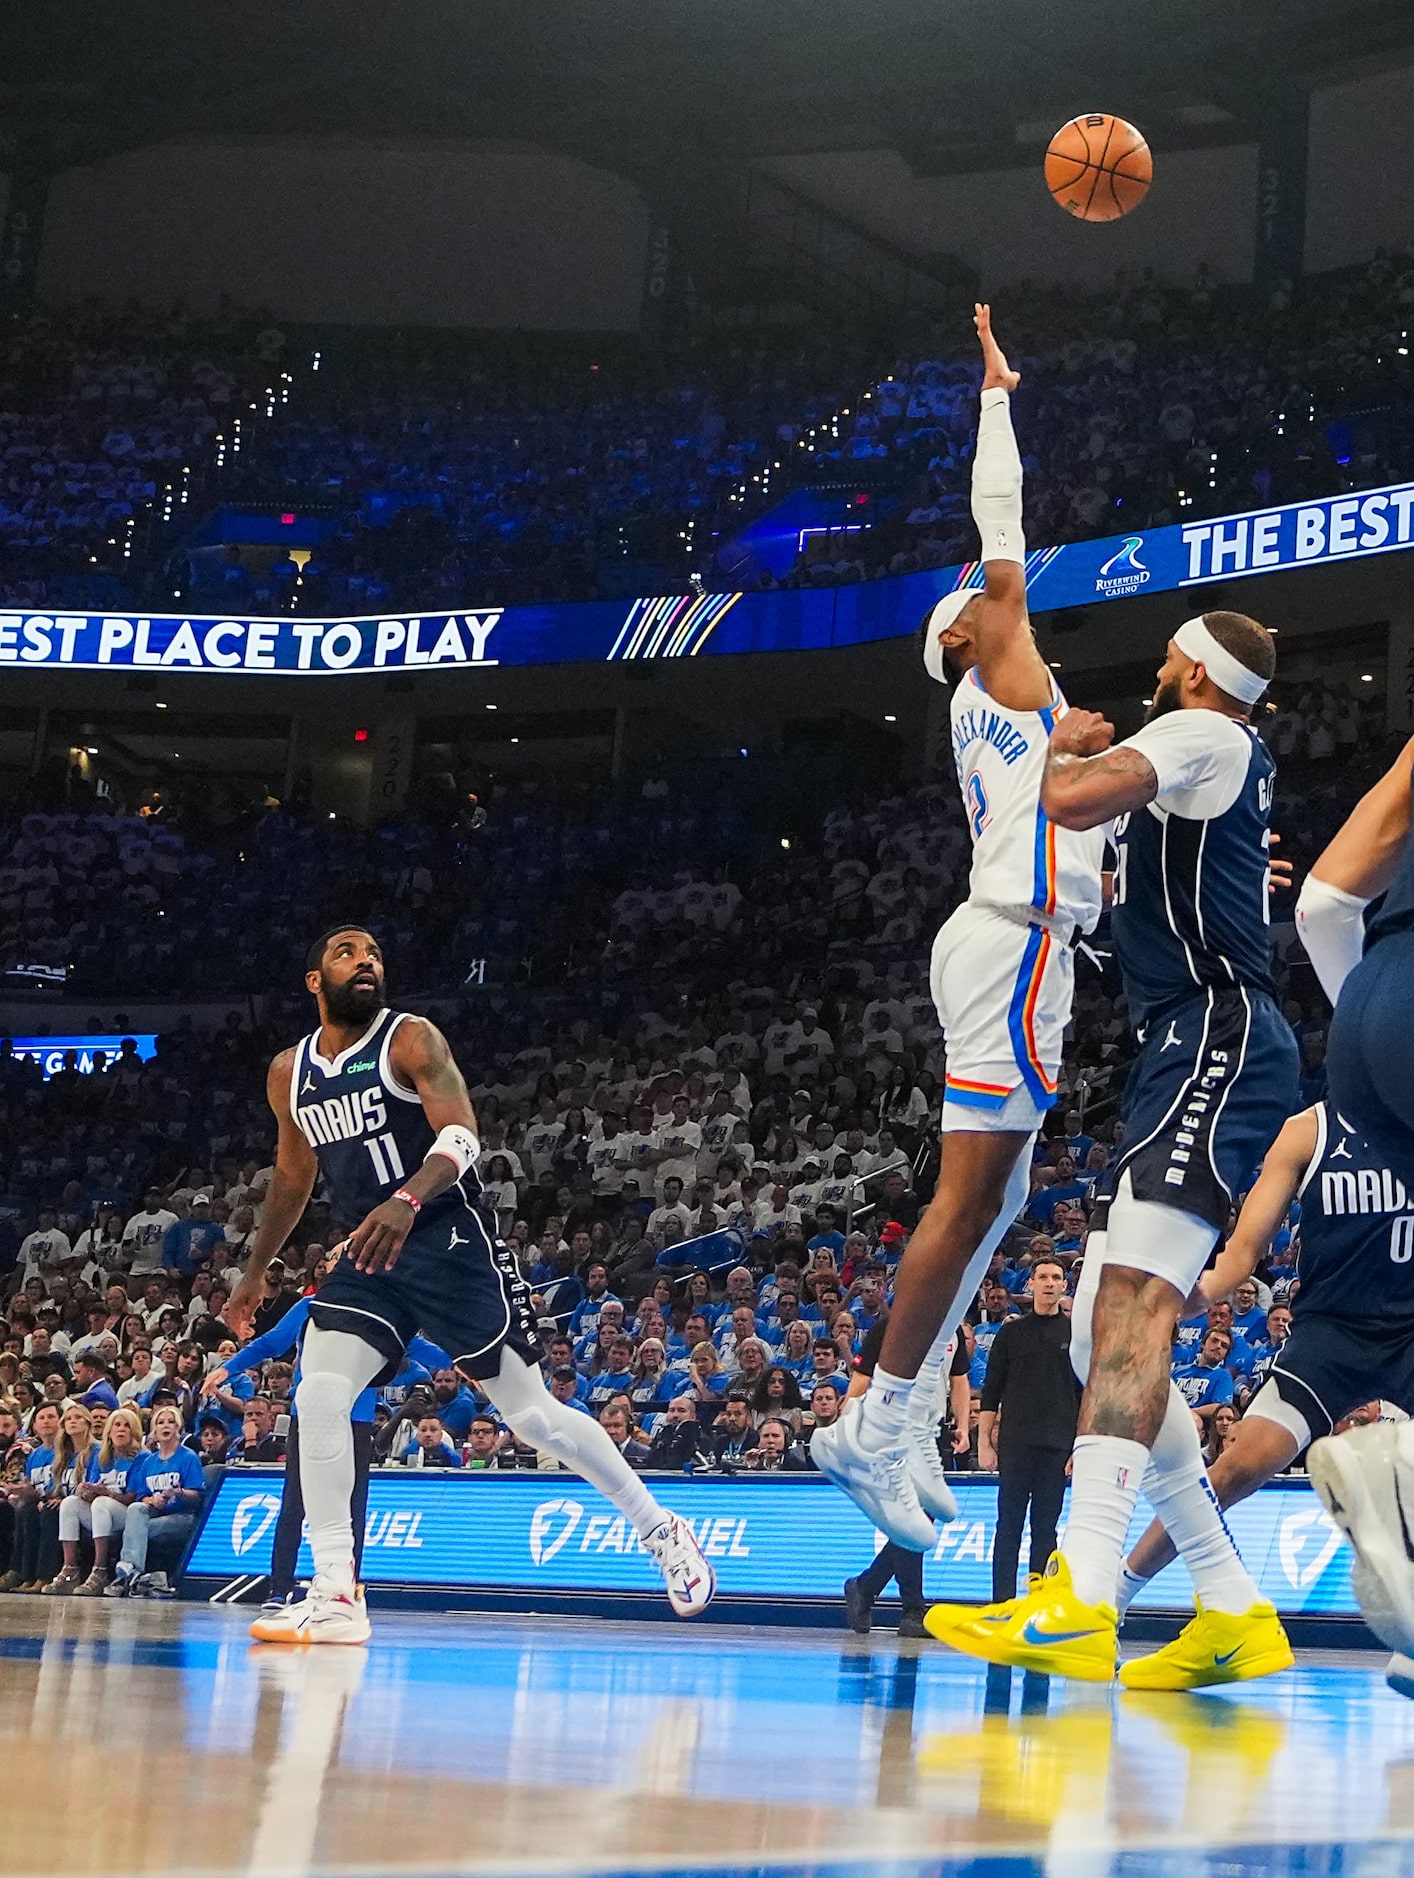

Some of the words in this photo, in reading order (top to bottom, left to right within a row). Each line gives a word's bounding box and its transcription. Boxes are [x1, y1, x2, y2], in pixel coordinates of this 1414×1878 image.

[1182, 514, 1280, 578] THE
[1096, 571, 1150, 591] RIVERWIND
[1105, 585, 1138, 597] CASINO
[99, 618, 279, 669] PLACE
[293, 623, 362, 669] TO
[374, 615, 499, 666] PLAY
[347, 1060, 376, 1075] chime
[298, 1086, 387, 1148] MAVS
[1165, 1050, 1229, 1186] MAVERICKS
[363, 1132, 405, 1186] 11
[1321, 1168, 1412, 1215] MAV
[1389, 1215, 1414, 1264] 0
